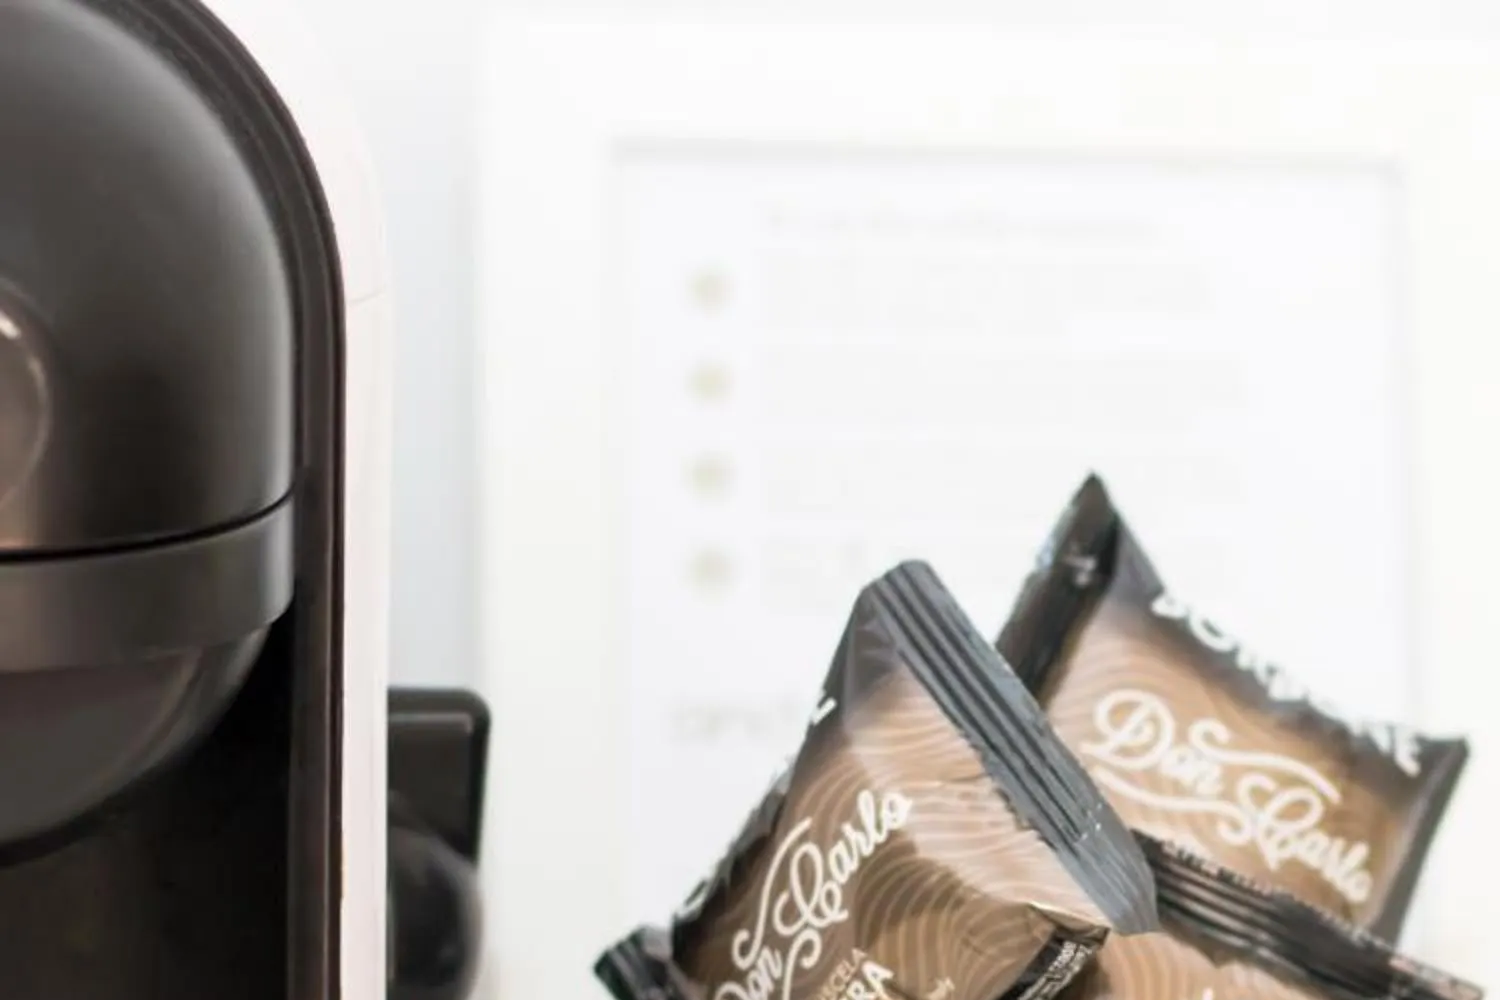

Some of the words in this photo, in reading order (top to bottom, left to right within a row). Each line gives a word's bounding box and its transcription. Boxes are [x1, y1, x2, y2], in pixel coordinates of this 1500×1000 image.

[772, 789, 913, 937] Carlo
[1082, 688, 1222, 796] Don
[1238, 772, 1374, 904] Carlo
